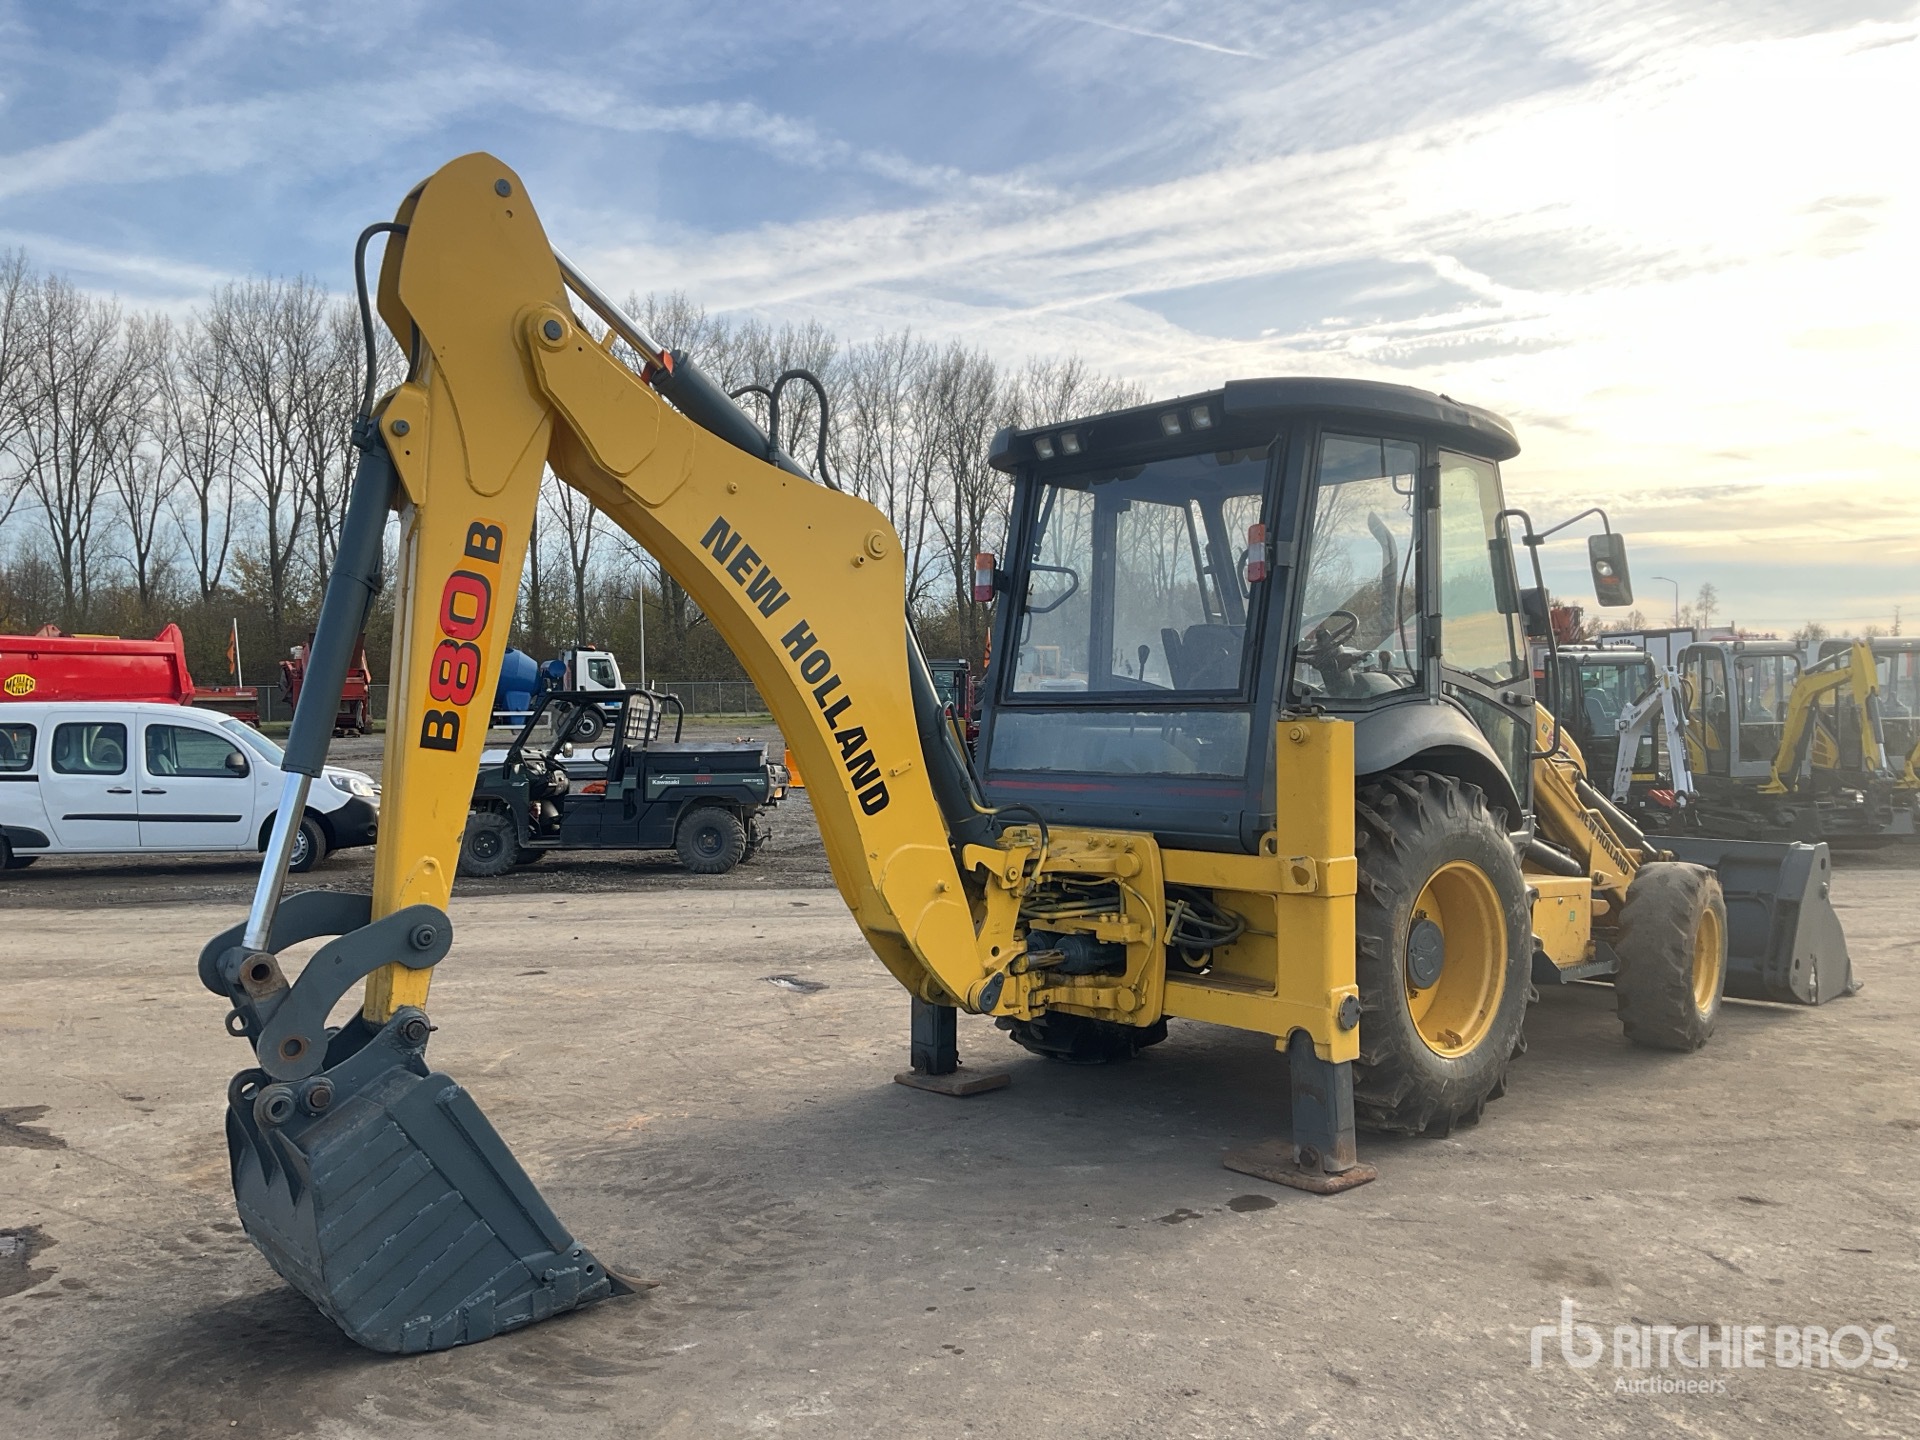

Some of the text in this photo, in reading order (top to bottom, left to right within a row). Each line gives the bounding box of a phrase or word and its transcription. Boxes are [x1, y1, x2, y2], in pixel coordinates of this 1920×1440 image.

[419, 521, 504, 752] B80B
[700, 515, 890, 817] NEW HOLLAND
[1577, 810, 1629, 875] NEW HOLLAND
